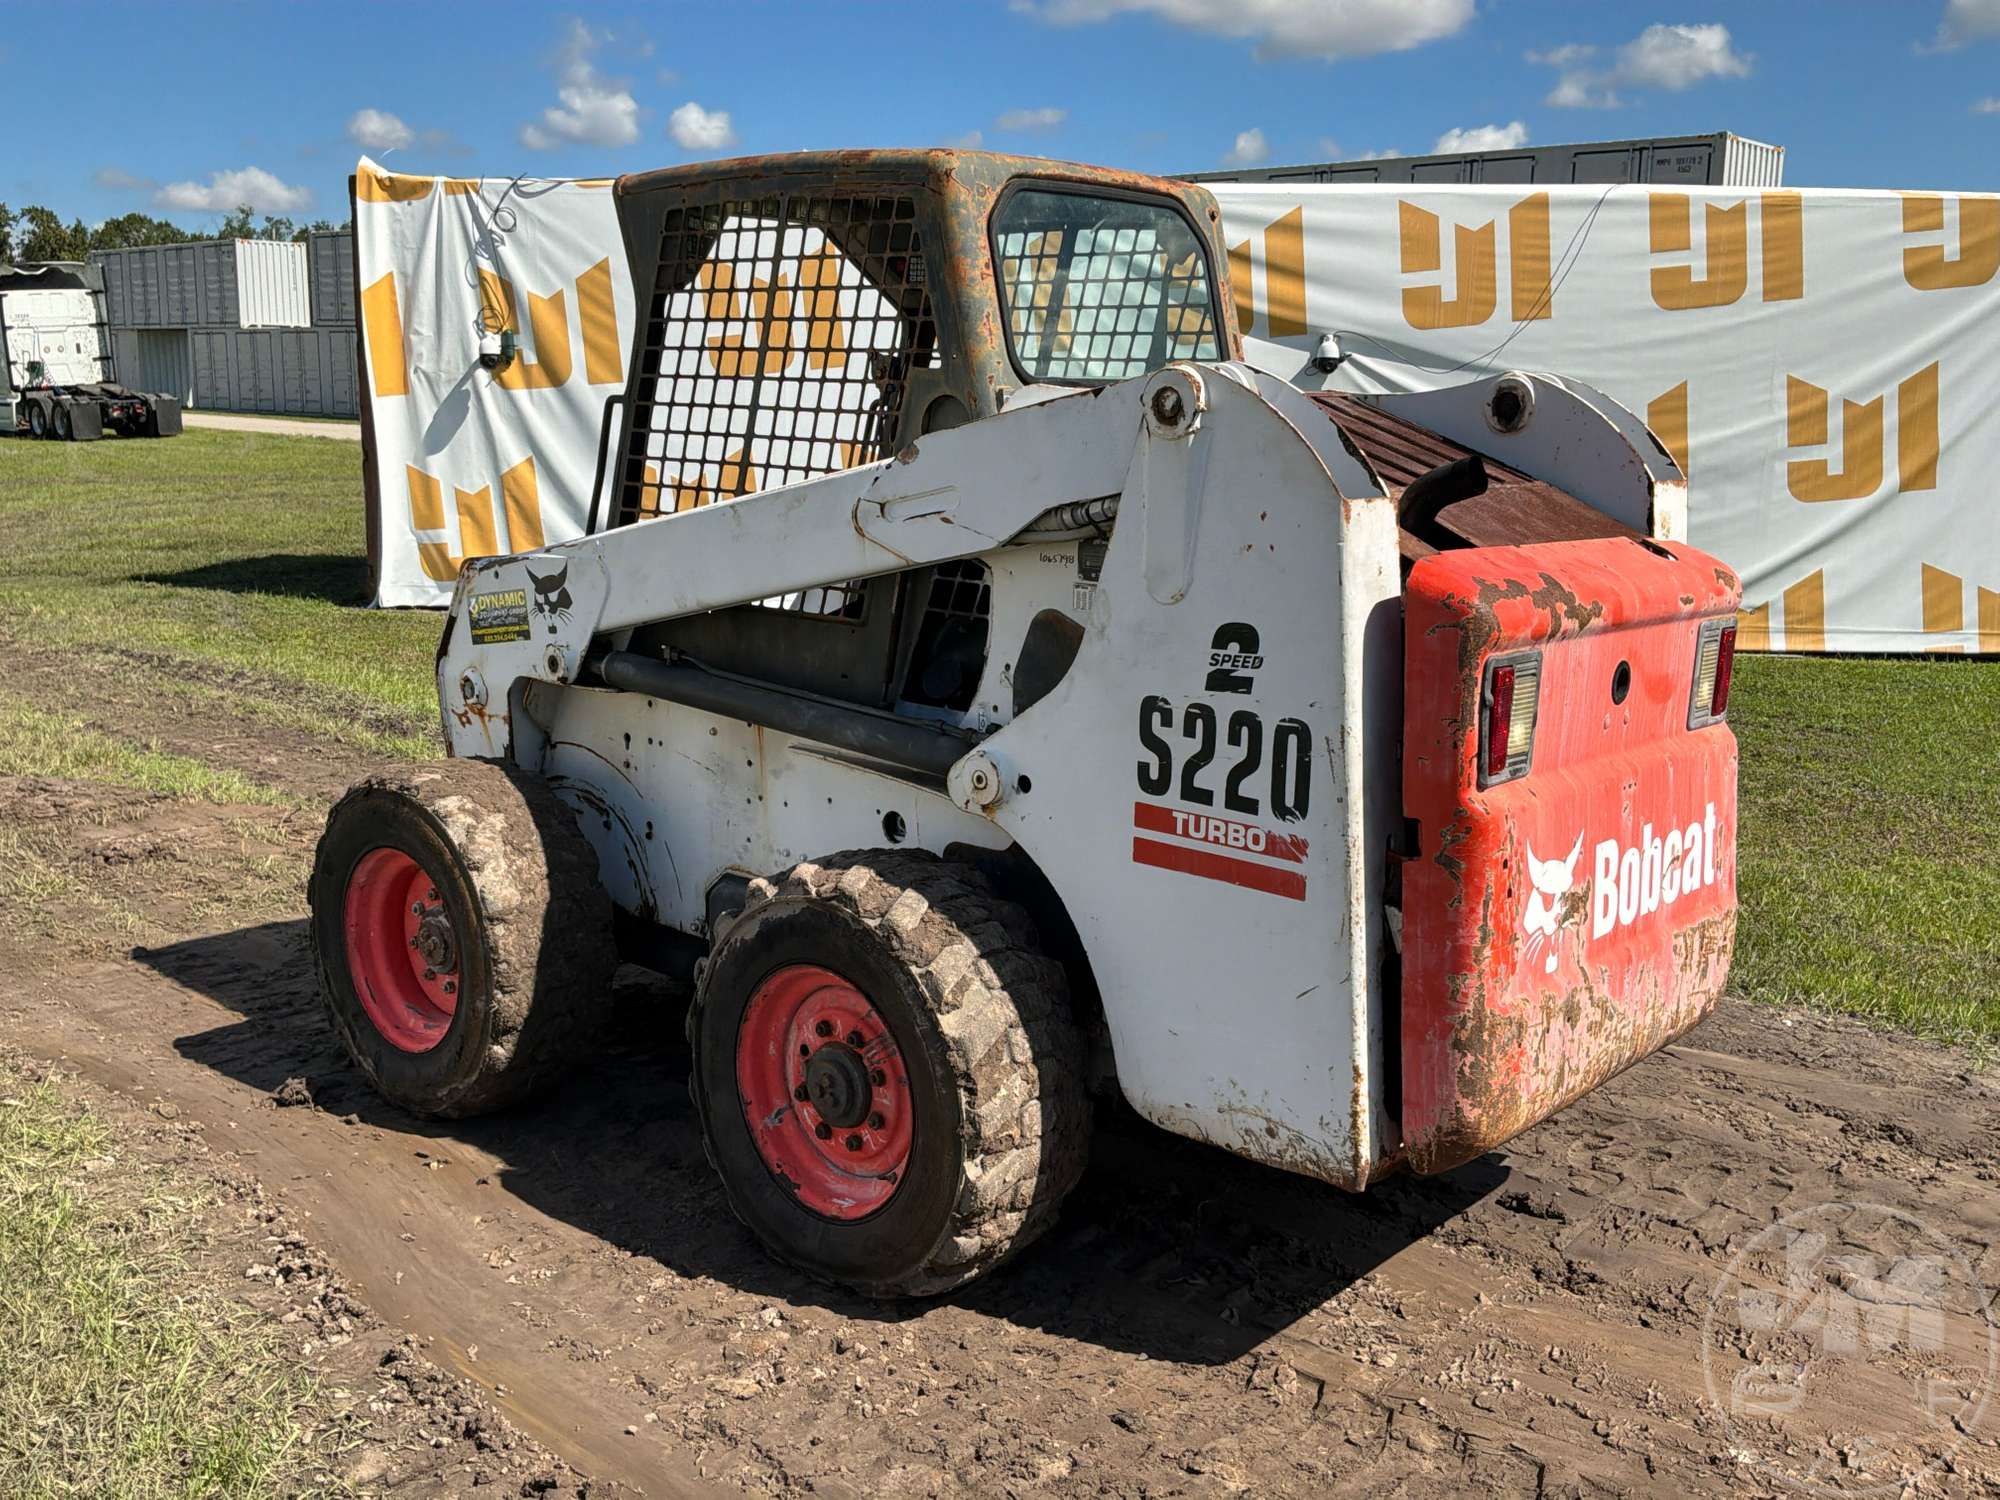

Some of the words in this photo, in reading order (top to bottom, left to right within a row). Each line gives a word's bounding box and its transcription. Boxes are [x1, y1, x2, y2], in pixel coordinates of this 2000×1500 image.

[479, 591, 525, 608] DYNAMIC
[1205, 622, 1260, 695] 2
[1208, 652, 1264, 671] SPEED
[1136, 695, 1313, 824] S220
[1172, 810, 1267, 853] TURBO
[1592, 802, 1718, 941] Bobcat
